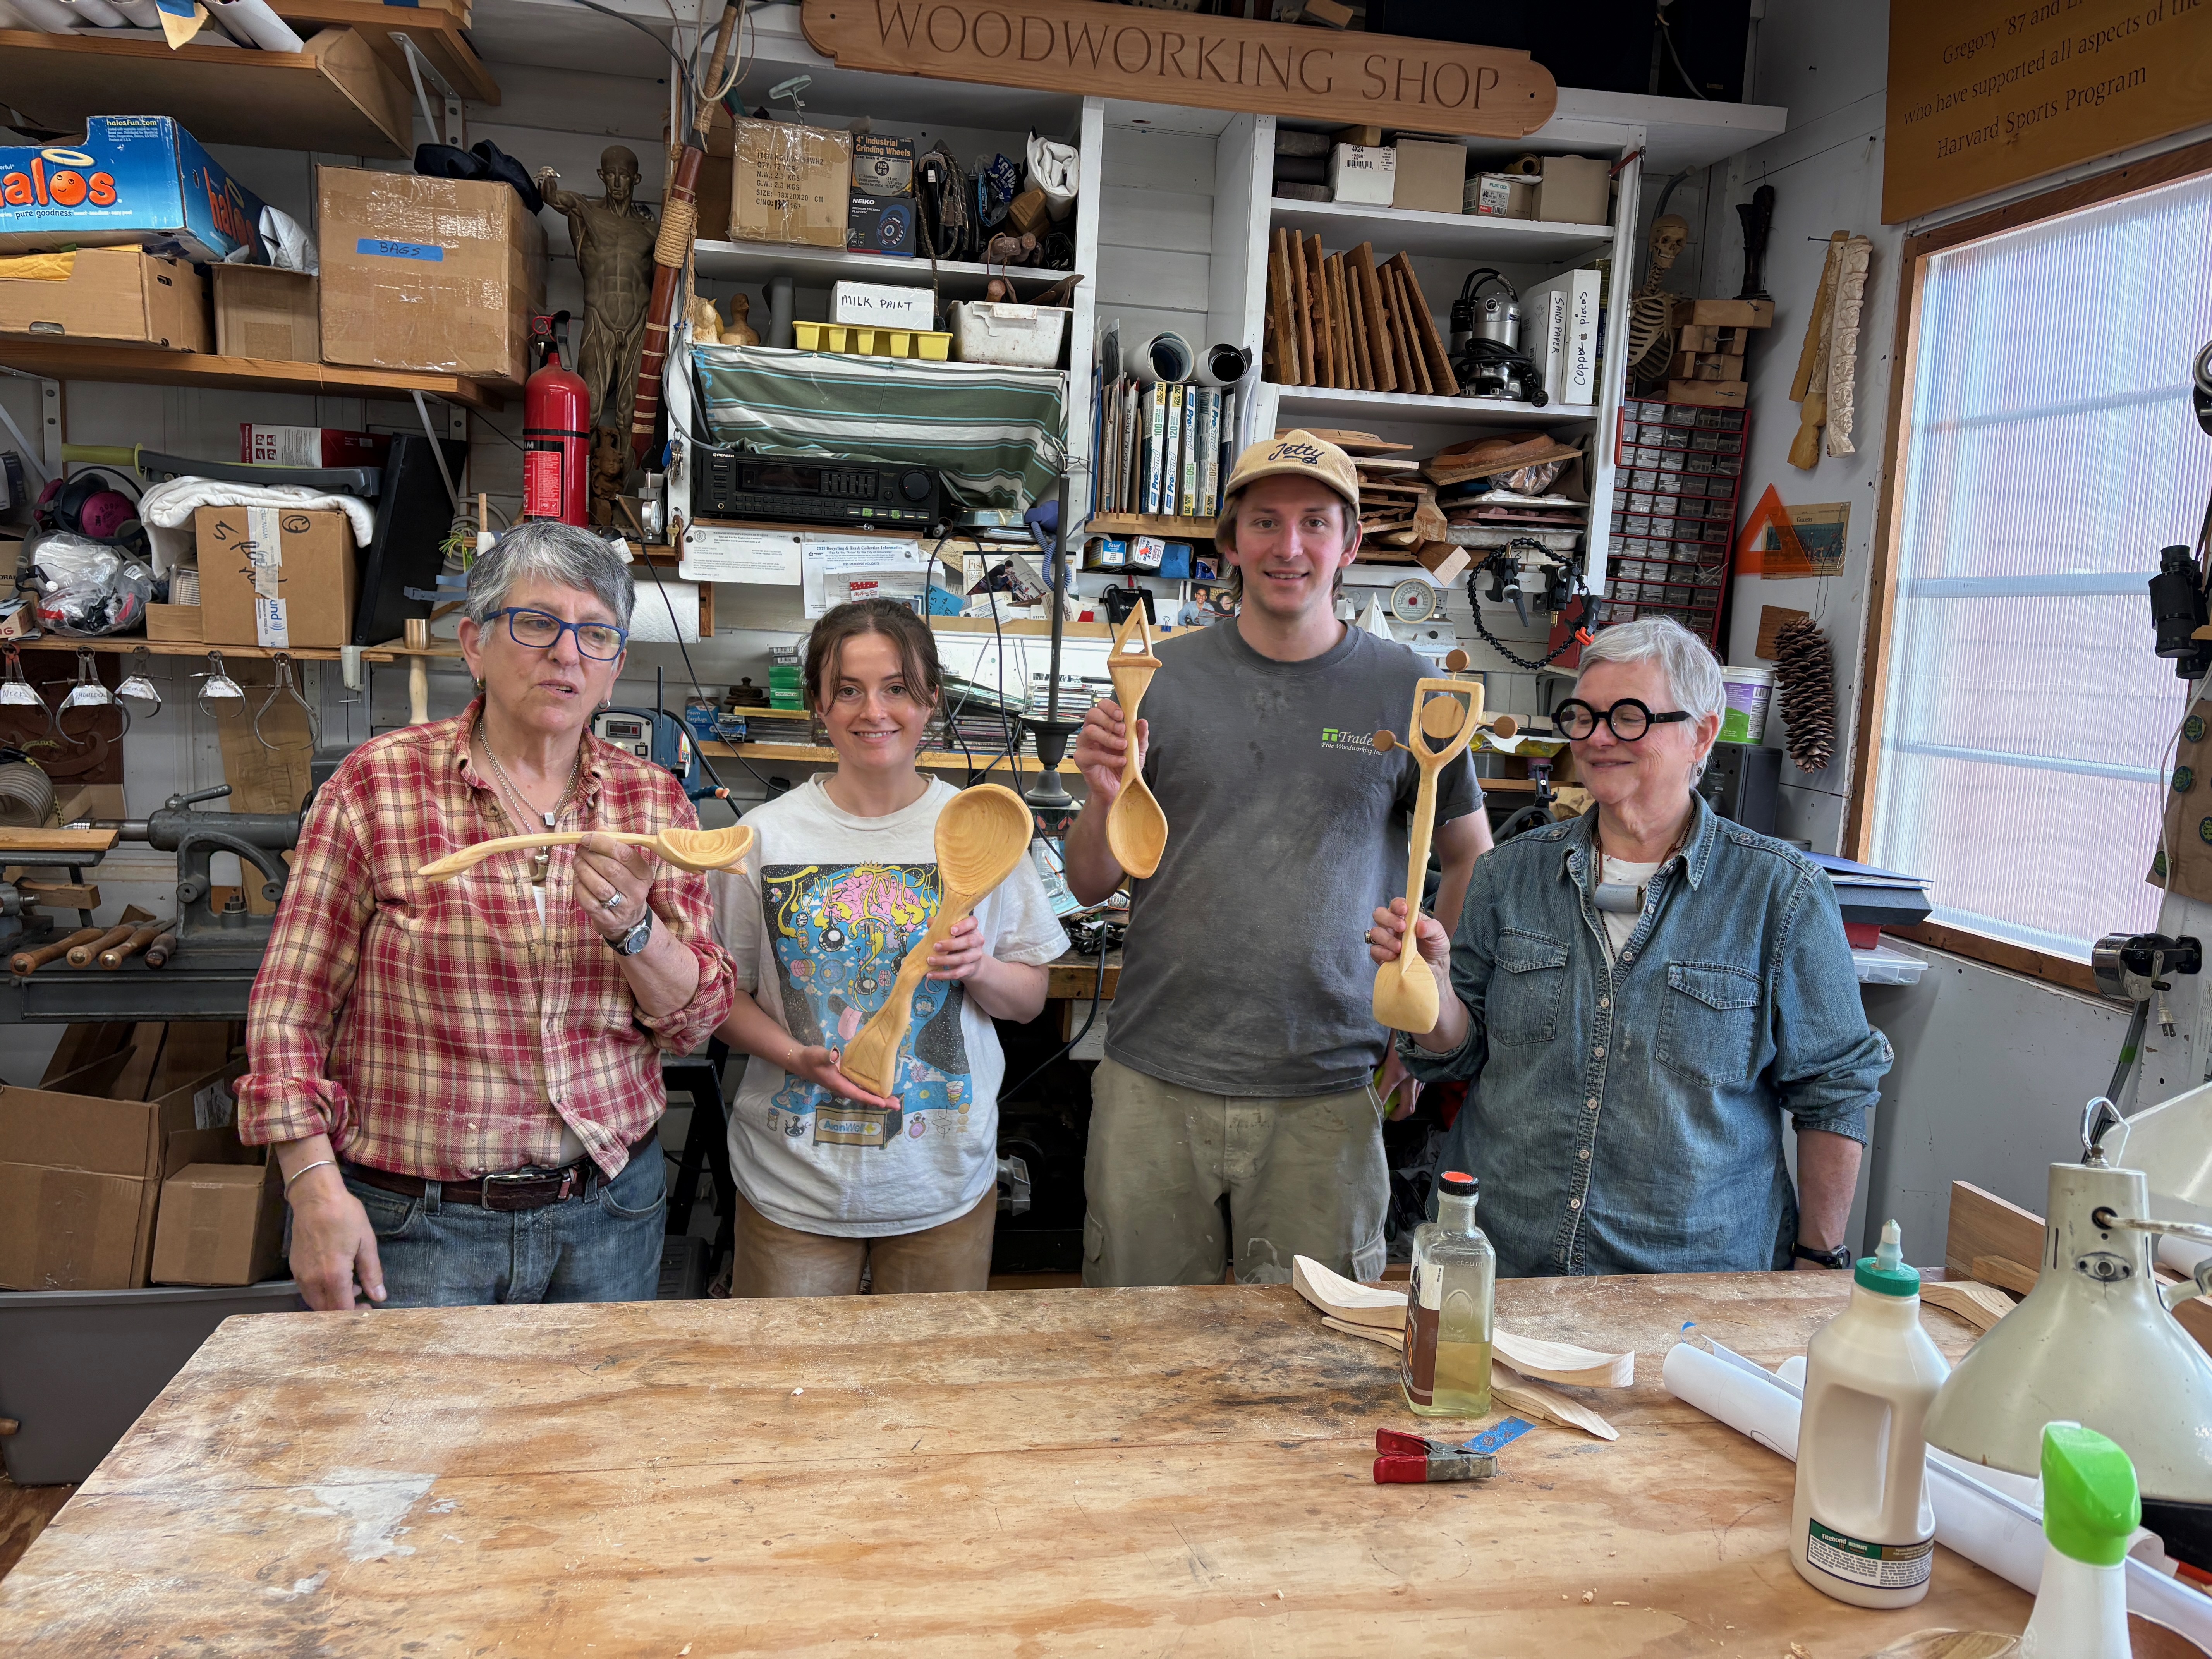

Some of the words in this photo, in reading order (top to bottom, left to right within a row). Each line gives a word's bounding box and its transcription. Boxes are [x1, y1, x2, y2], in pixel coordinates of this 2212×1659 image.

[1943, 27, 1999, 64] Gregory
[2030, 1, 2060, 25] and
[876, 0, 1334, 94] WOODWORKING
[1362, 54, 1499, 109] SHOP
[1904, 103, 1932, 125] who
[1936, 87, 1967, 112] have
[1972, 50, 2045, 98] supported
[2051, 39, 2071, 65] all
[2078, 15, 2140, 57] aspects
[1937, 116, 1999, 159] Harvard
[2006, 99, 2057, 134] Sports
[2065, 67, 2147, 112] Program
[866, 136, 898, 147] Industrial
[856, 144, 884, 155] Grinding
[886, 147, 911, 156] Wheels
[0, 156, 117, 208] alos
[756, 198, 773, 206] C/NO:
[777, 192, 808, 201] 38X20X20
[15, 211, 34, 220] pure
[36, 209, 72, 218] goodness
[380, 242, 421, 256] BAGS
[842, 295, 872, 308] MILK
[880, 299, 913, 311] PAINT
[1555, 297, 1565, 323] SAND
[1551, 326, 1562, 354] PAPER
[1157, 383, 1164, 392] 20
[1175, 386, 1182, 394] 20
[1154, 423, 1162, 437] 100
[1170, 426, 1178, 440] 120
[1210, 409, 1219, 451] ProSand
[1268, 443, 1325, 464] Jetty
[1152, 448, 1161, 491] ProSand
[1167, 451, 1176, 493] ProSand
[1186, 463, 1194, 476] 150
[1184, 506, 1191, 514] 20
[1207, 507, 1213, 515] 20
[3, 690, 27, 698] NECK
[1338, 731, 1375, 747] Trade
[1336, 743, 1373, 755] Woodworking
[767, 866, 846, 938] TAME
[1821, 1533, 1847, 1544] Titebond
[1848, 1541, 1868, 1551] ULTIMATE
